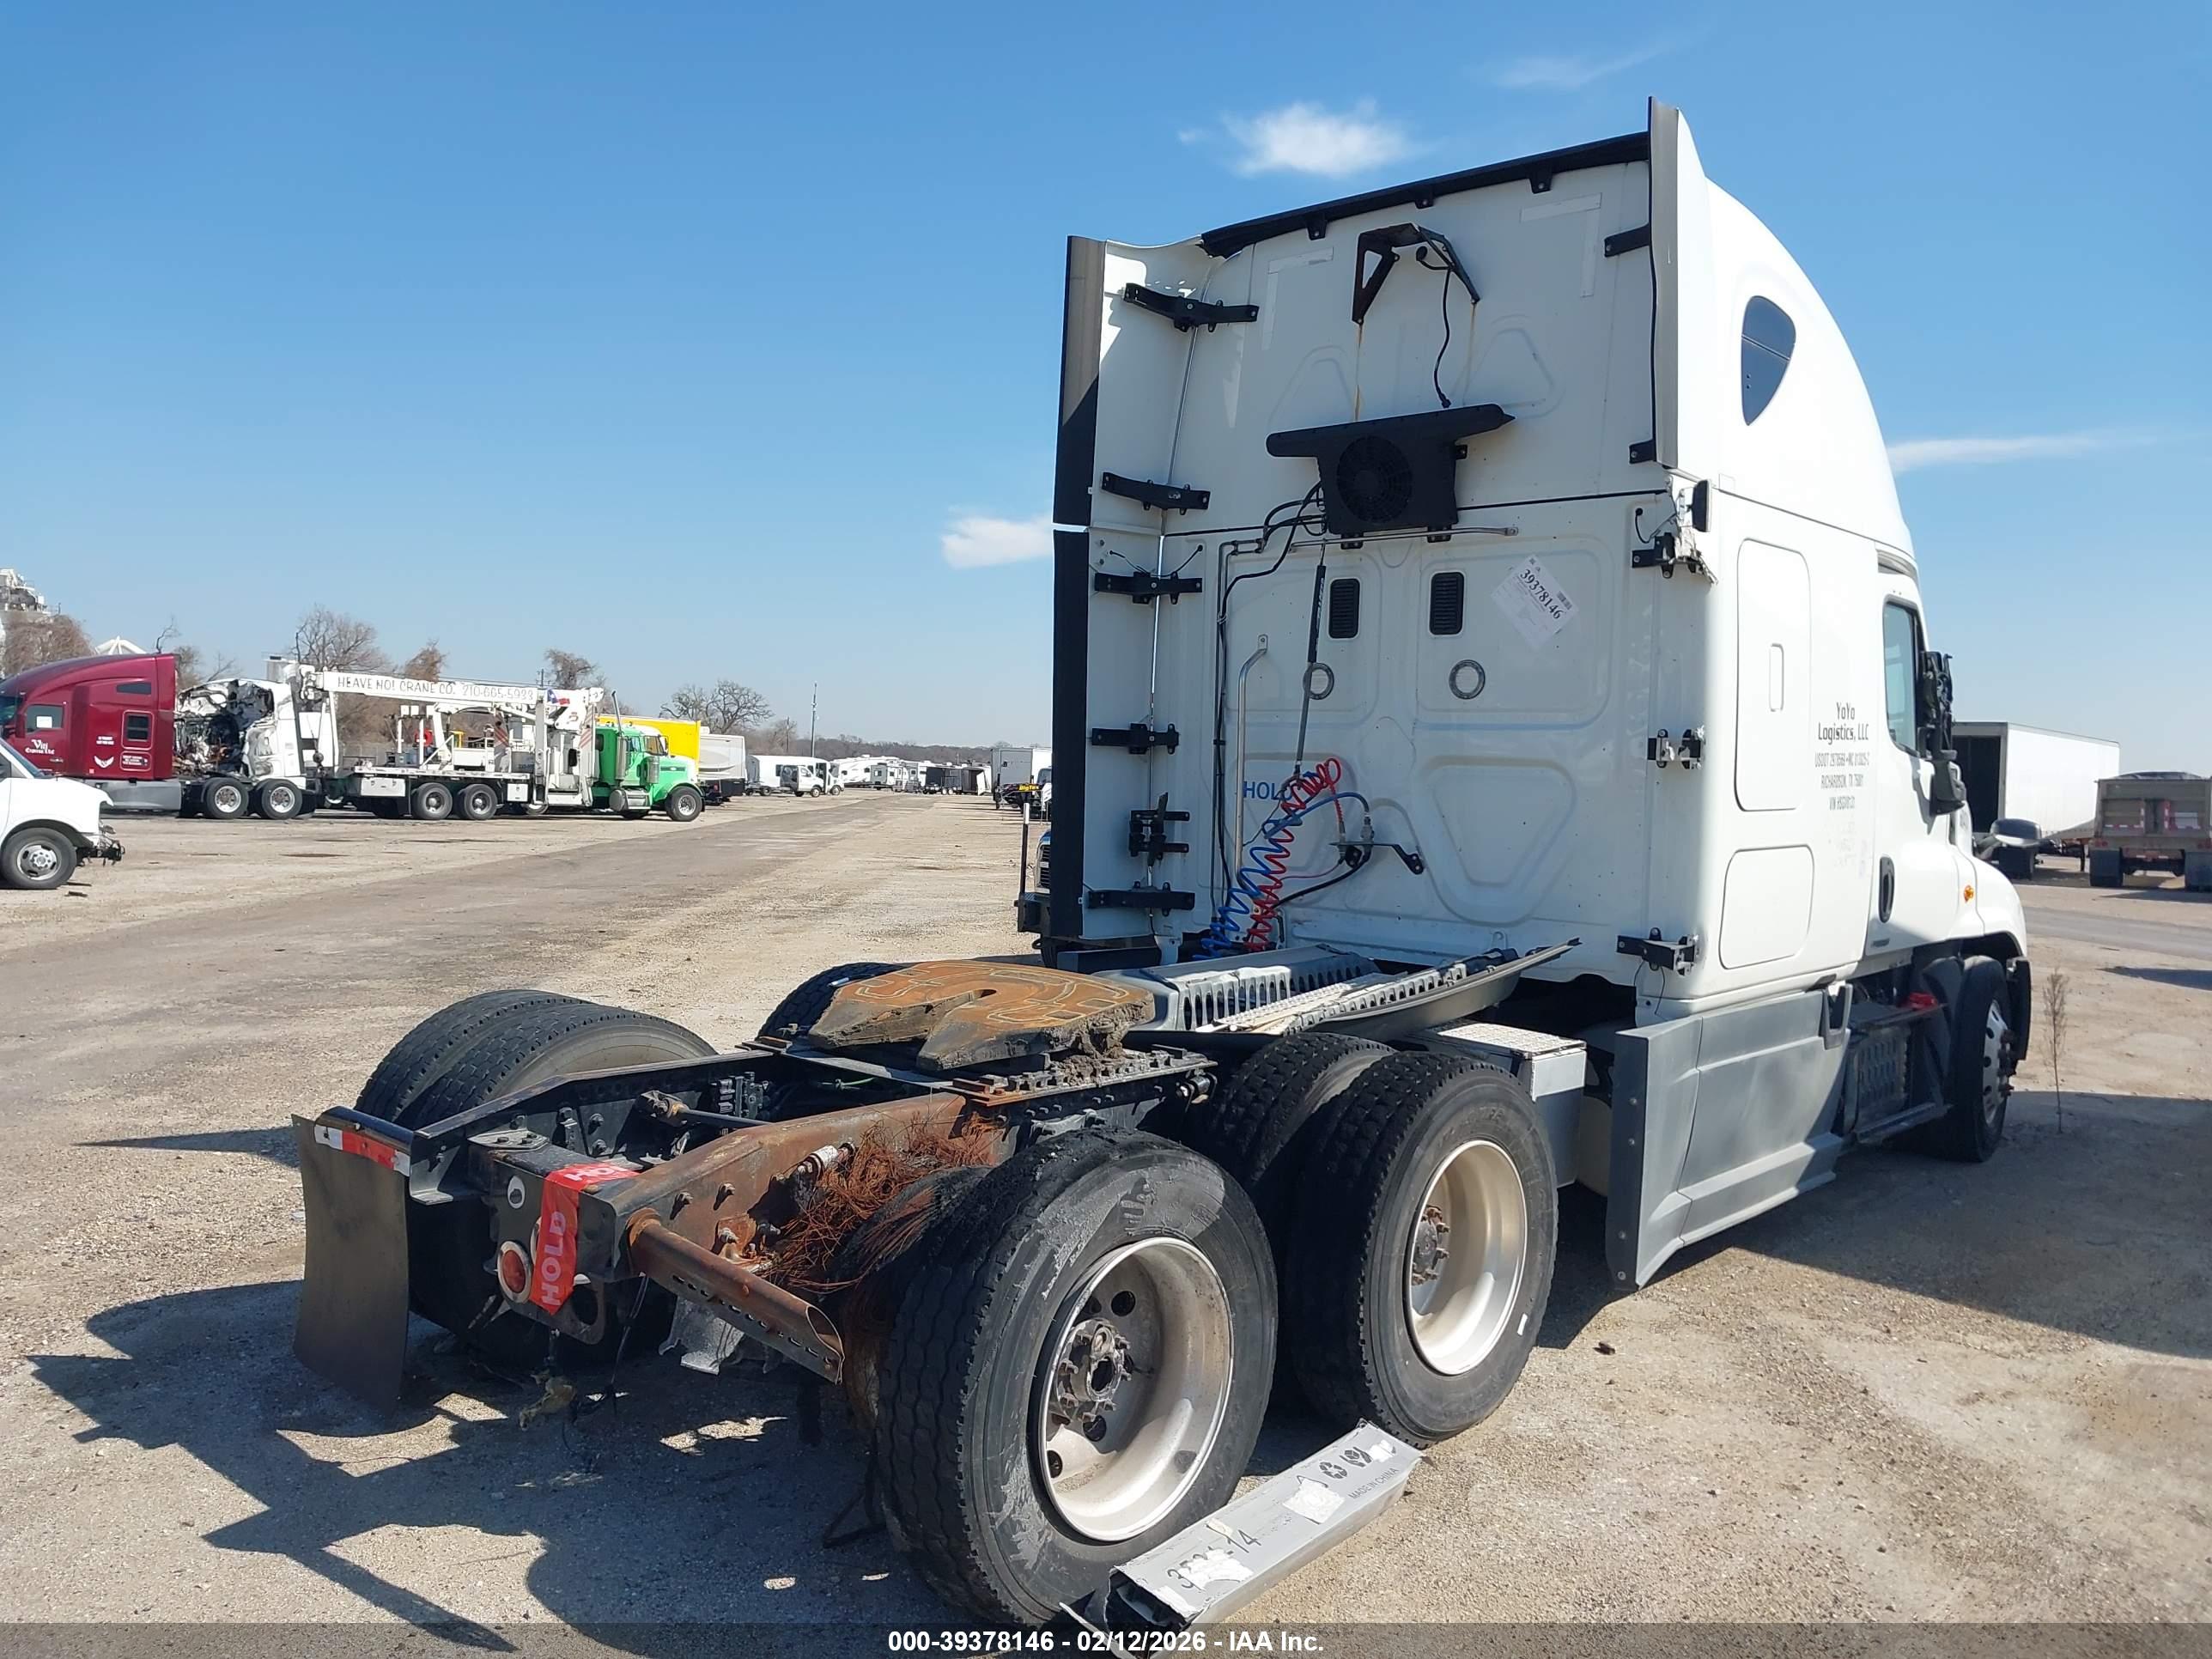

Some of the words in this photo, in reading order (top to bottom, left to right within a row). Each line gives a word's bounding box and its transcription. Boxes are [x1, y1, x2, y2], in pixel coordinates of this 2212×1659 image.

[1519, 568, 1564, 620] 39378146
[337, 676, 372, 690] HEAVE
[376, 678, 396, 692] HO!
[399, 680, 435, 694] CRANE
[439, 684, 456, 695] CO.
[1836, 702, 1856, 720] YoYo
[1818, 722, 1856, 745] Logistics,
[1857, 723, 1869, 740] LLC
[541, 1210, 566, 1306] HOLD
[1347, 1485, 1371, 1499] MADE
[1374, 1468, 1400, 1485] CHINA
